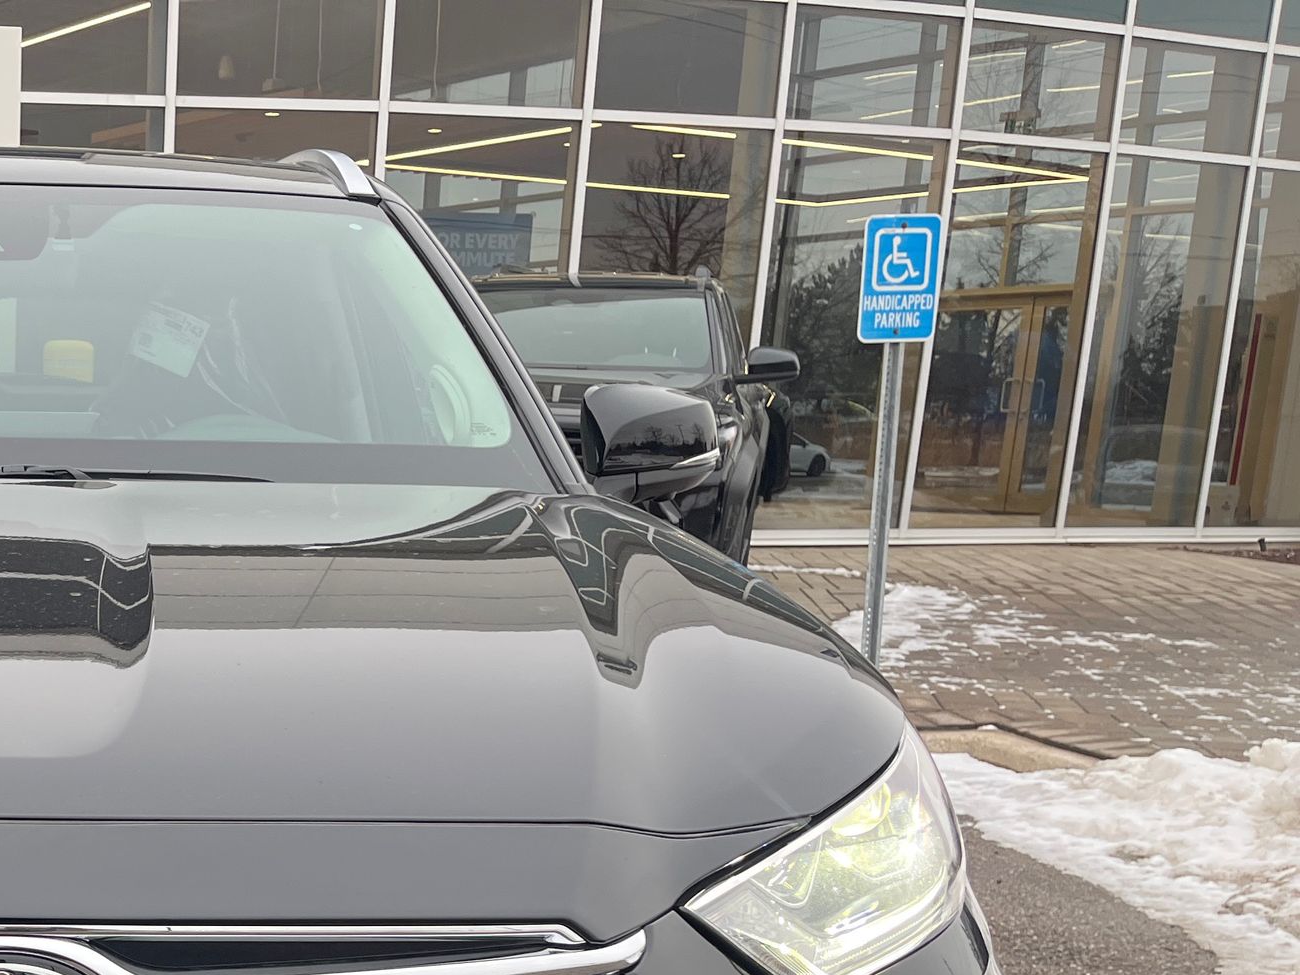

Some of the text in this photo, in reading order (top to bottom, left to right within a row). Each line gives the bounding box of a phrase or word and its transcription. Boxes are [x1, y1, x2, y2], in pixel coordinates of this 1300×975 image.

[437, 232, 520, 250] OR EVERY
[452, 250, 517, 268] MMUTE
[863, 293, 934, 311] HANDICAPPED
[873, 312, 920, 329] PARKING
